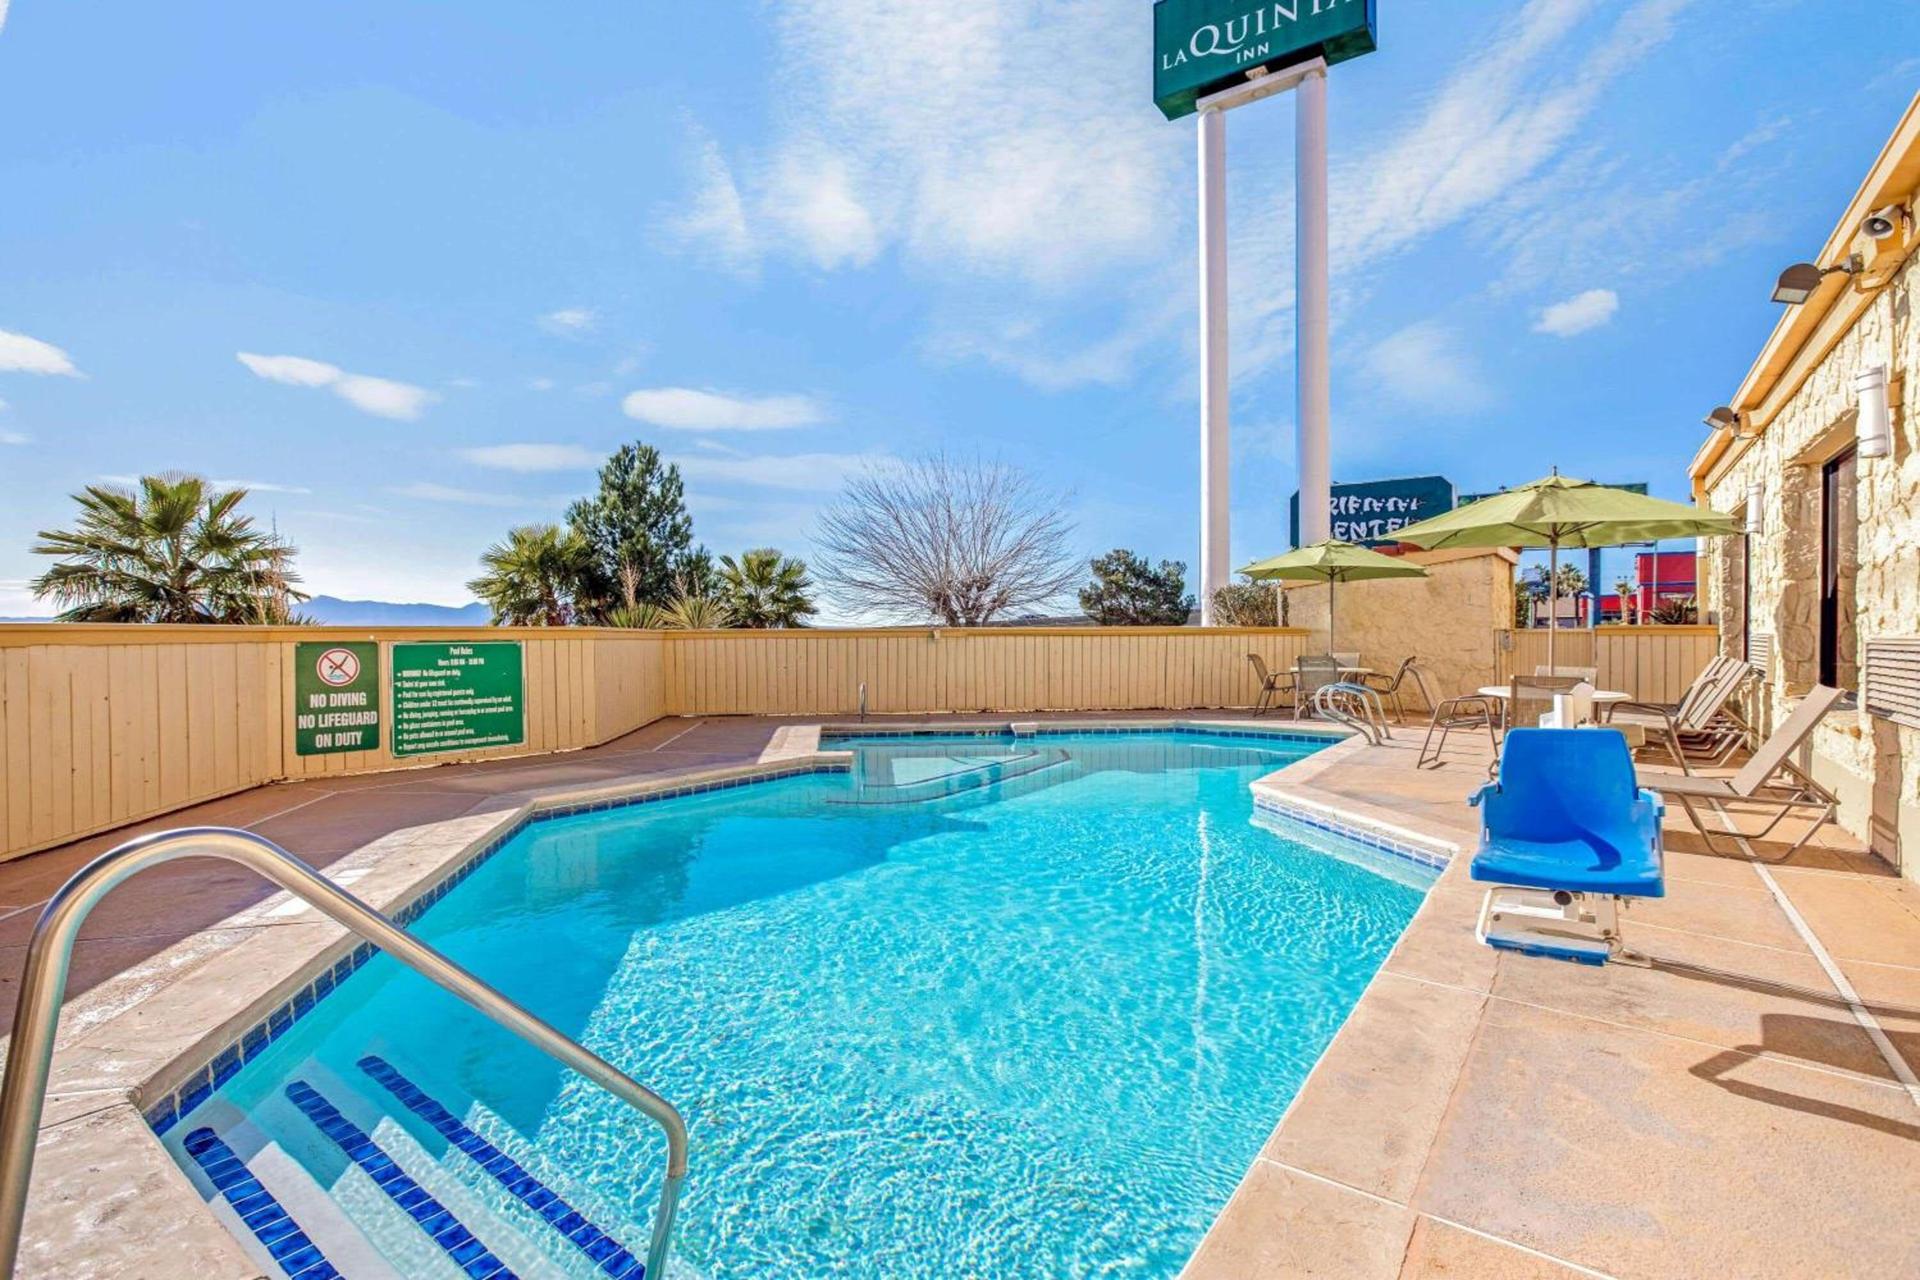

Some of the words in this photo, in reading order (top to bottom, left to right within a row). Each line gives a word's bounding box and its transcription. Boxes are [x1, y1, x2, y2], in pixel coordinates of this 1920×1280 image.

[1162, 49, 1188, 71] LA
[1236, 42, 1270, 65] INN
[310, 694, 327, 708] NO
[329, 692, 367, 707] DIVING
[298, 714, 315, 729] NO
[318, 710, 378, 728] LIFEGUARD
[315, 733, 332, 748] ON
[335, 731, 362, 746] DUTY
